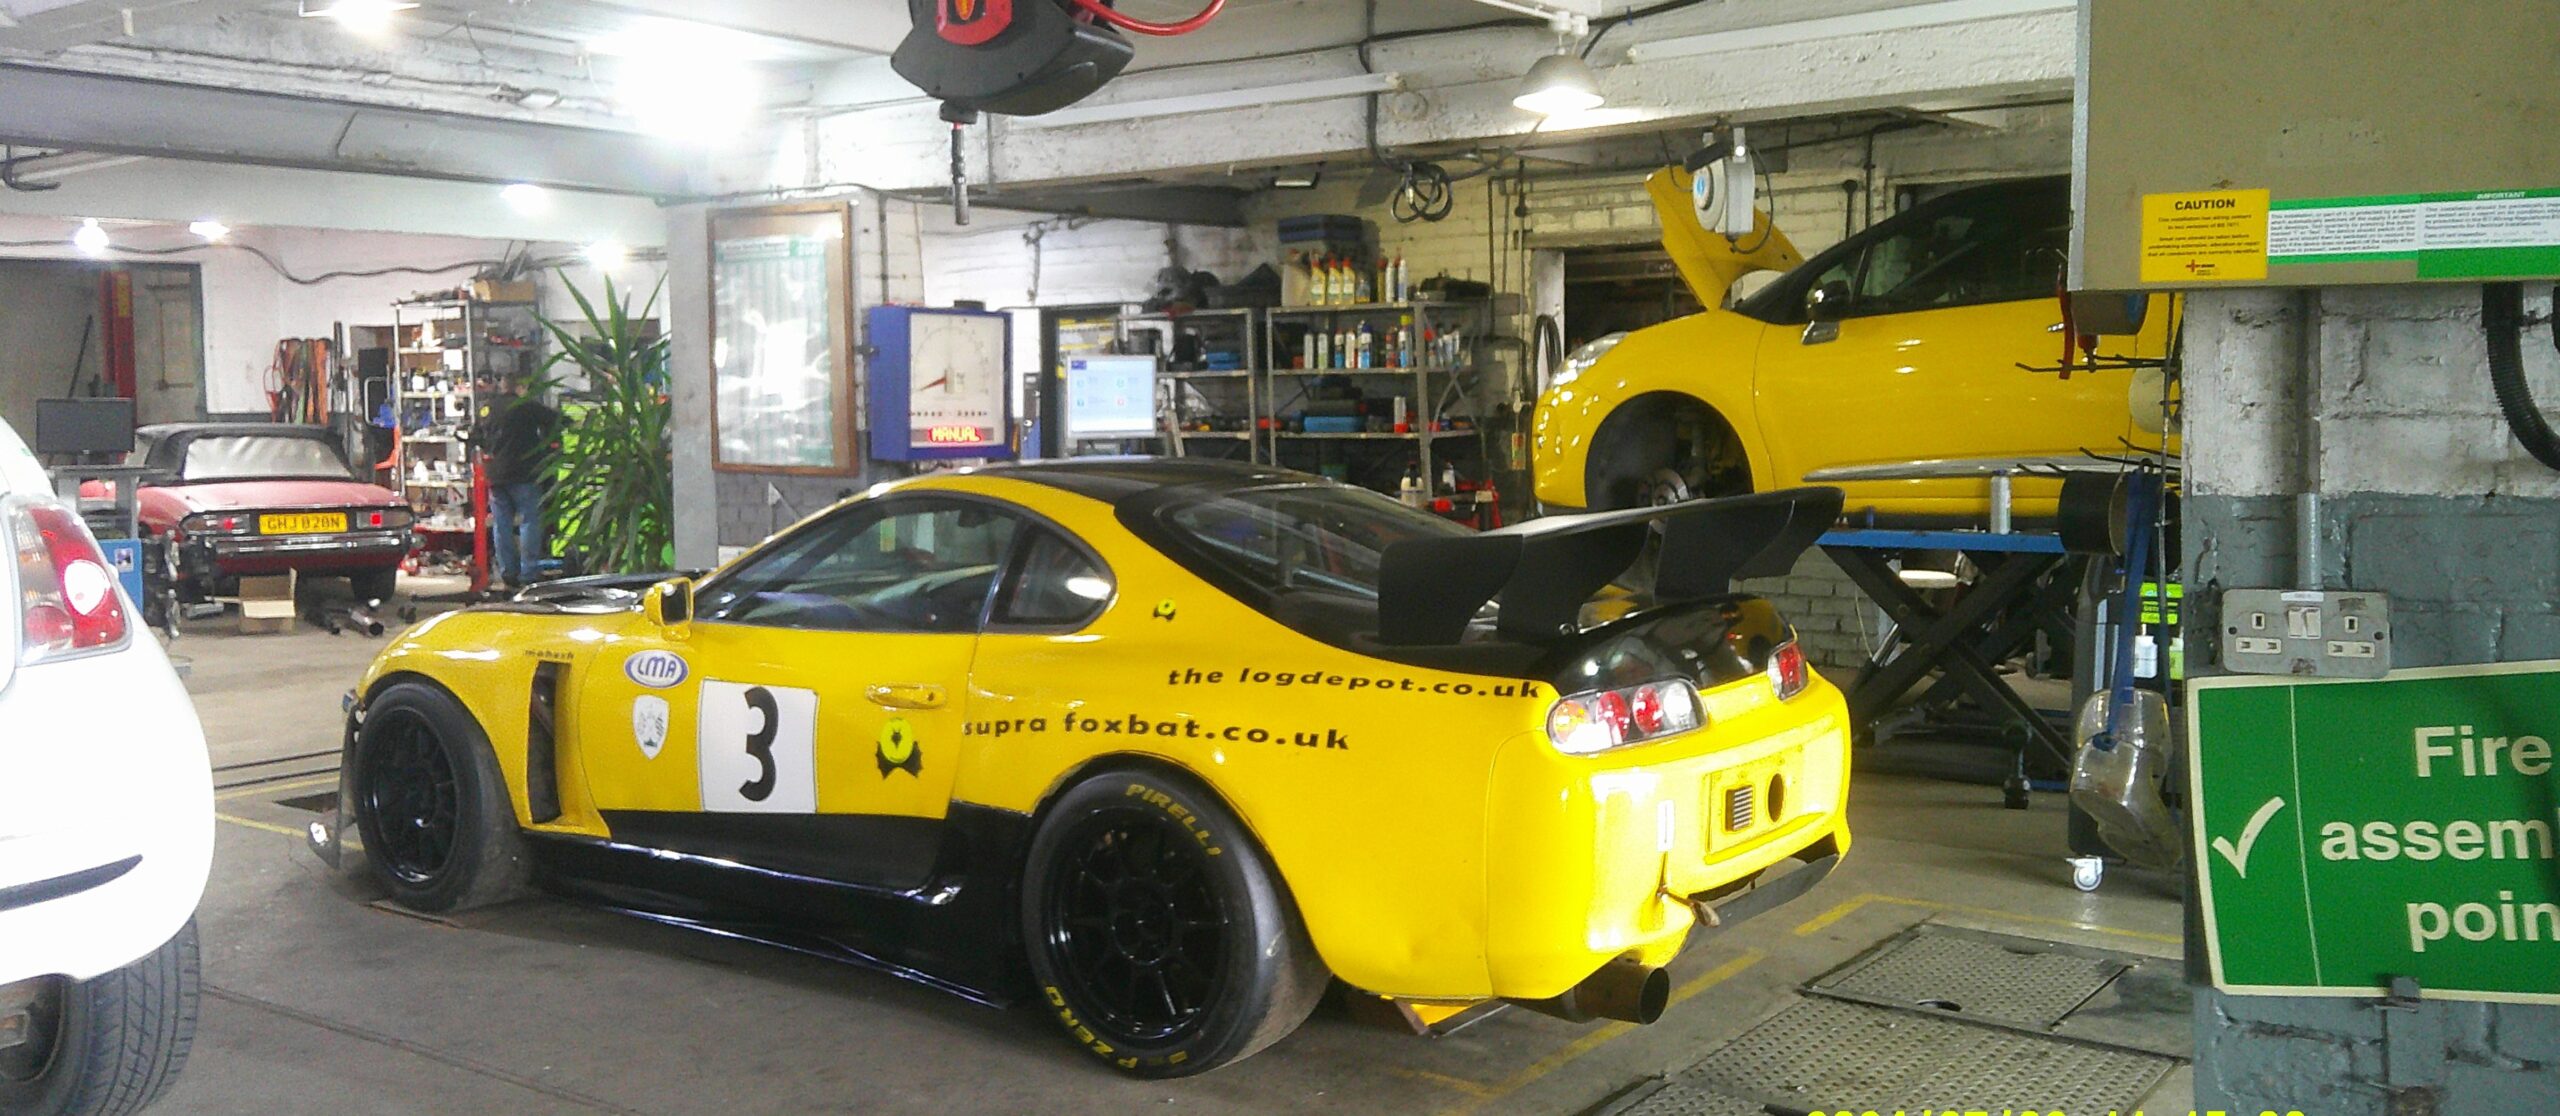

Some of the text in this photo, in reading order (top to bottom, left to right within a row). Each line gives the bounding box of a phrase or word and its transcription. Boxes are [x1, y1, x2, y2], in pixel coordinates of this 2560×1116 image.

[2175, 198, 2236, 210] CAUTION
[930, 427, 981, 442] MANUAL
[637, 656, 677, 678] LMA
[1168, 667, 1540, 699] the logdepot.co.uk
[738, 686, 779, 802] 3
[963, 713, 1350, 751] supra foxbat.co.uk
[2413, 725, 2553, 778] Fire
[1125, 783, 1223, 857] PIRELLI
[2320, 806, 2560, 861] assem
